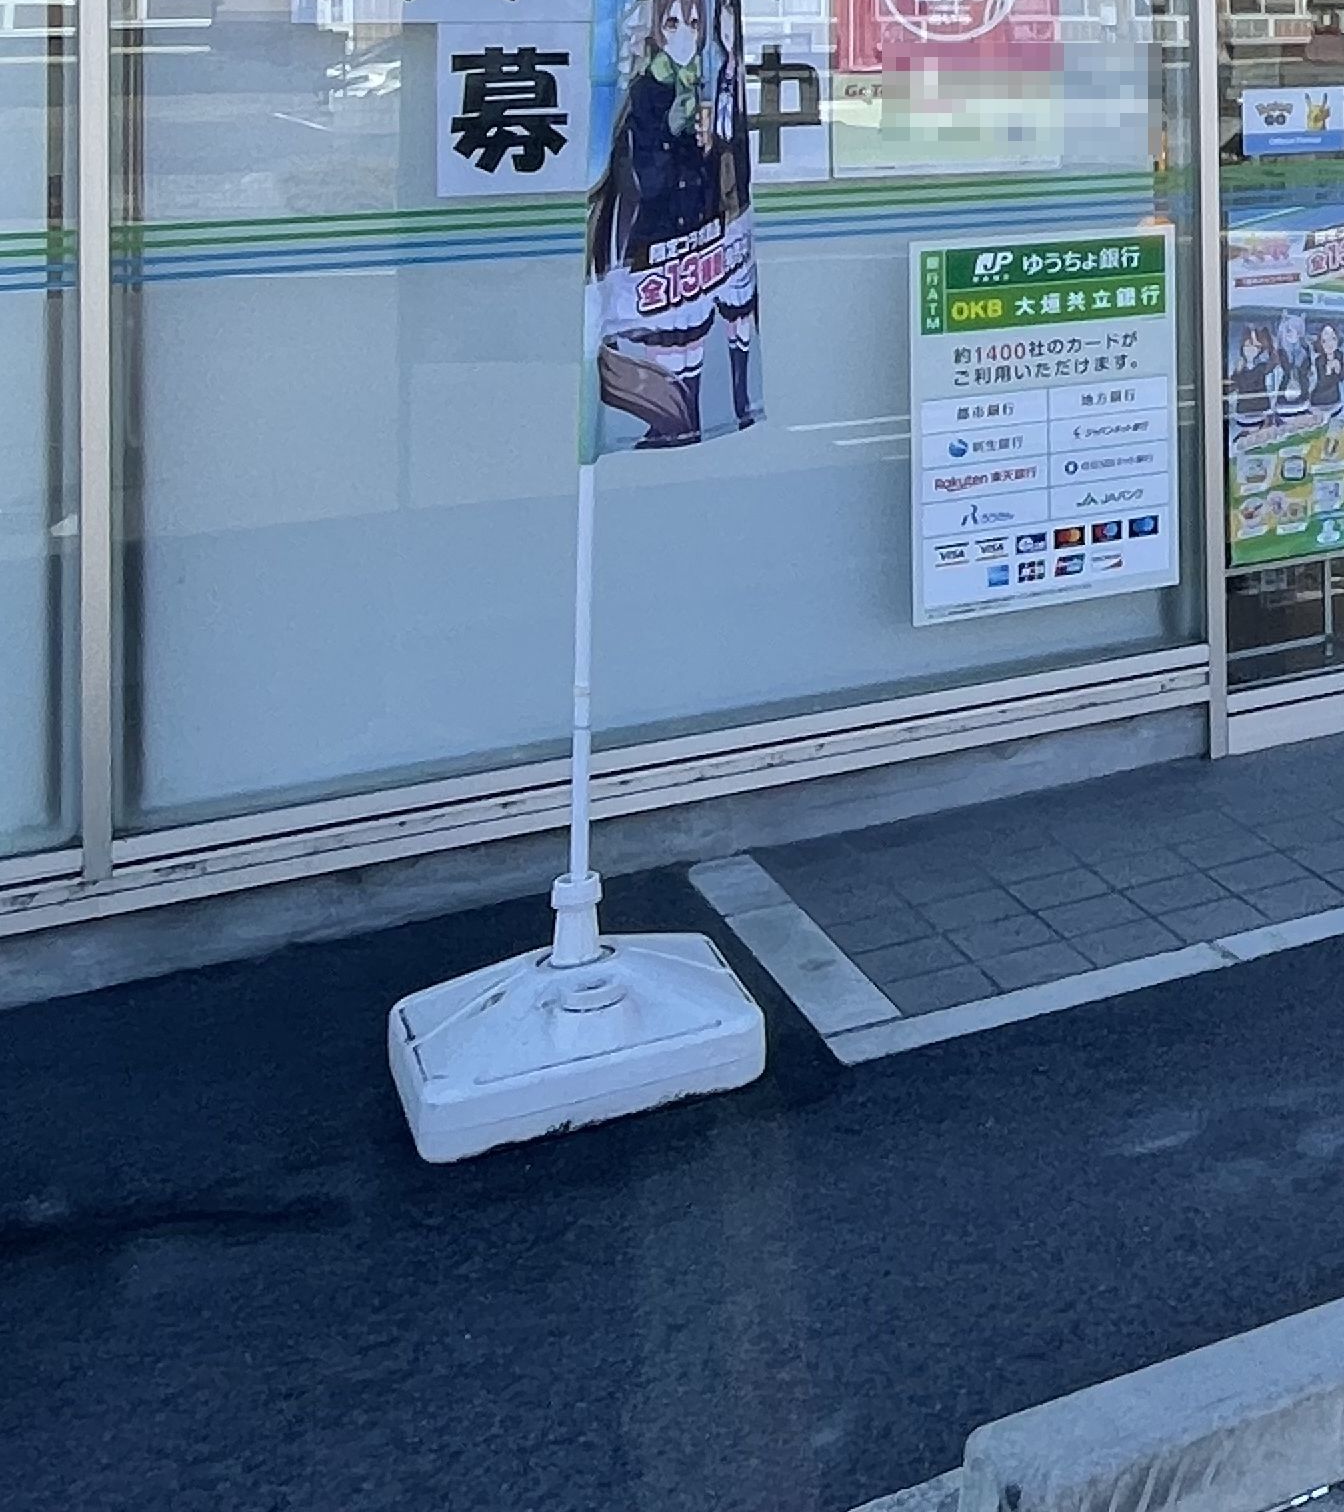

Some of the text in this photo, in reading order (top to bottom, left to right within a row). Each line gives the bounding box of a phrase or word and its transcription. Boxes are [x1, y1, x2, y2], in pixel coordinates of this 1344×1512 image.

[1022, 246, 1140, 275] ゆうちょ銀行
[951, 299, 1003, 320] OKB
[953, 331, 1138, 364] 約1400社のカードが
[954, 355, 1138, 386] ご利用いただけます。
